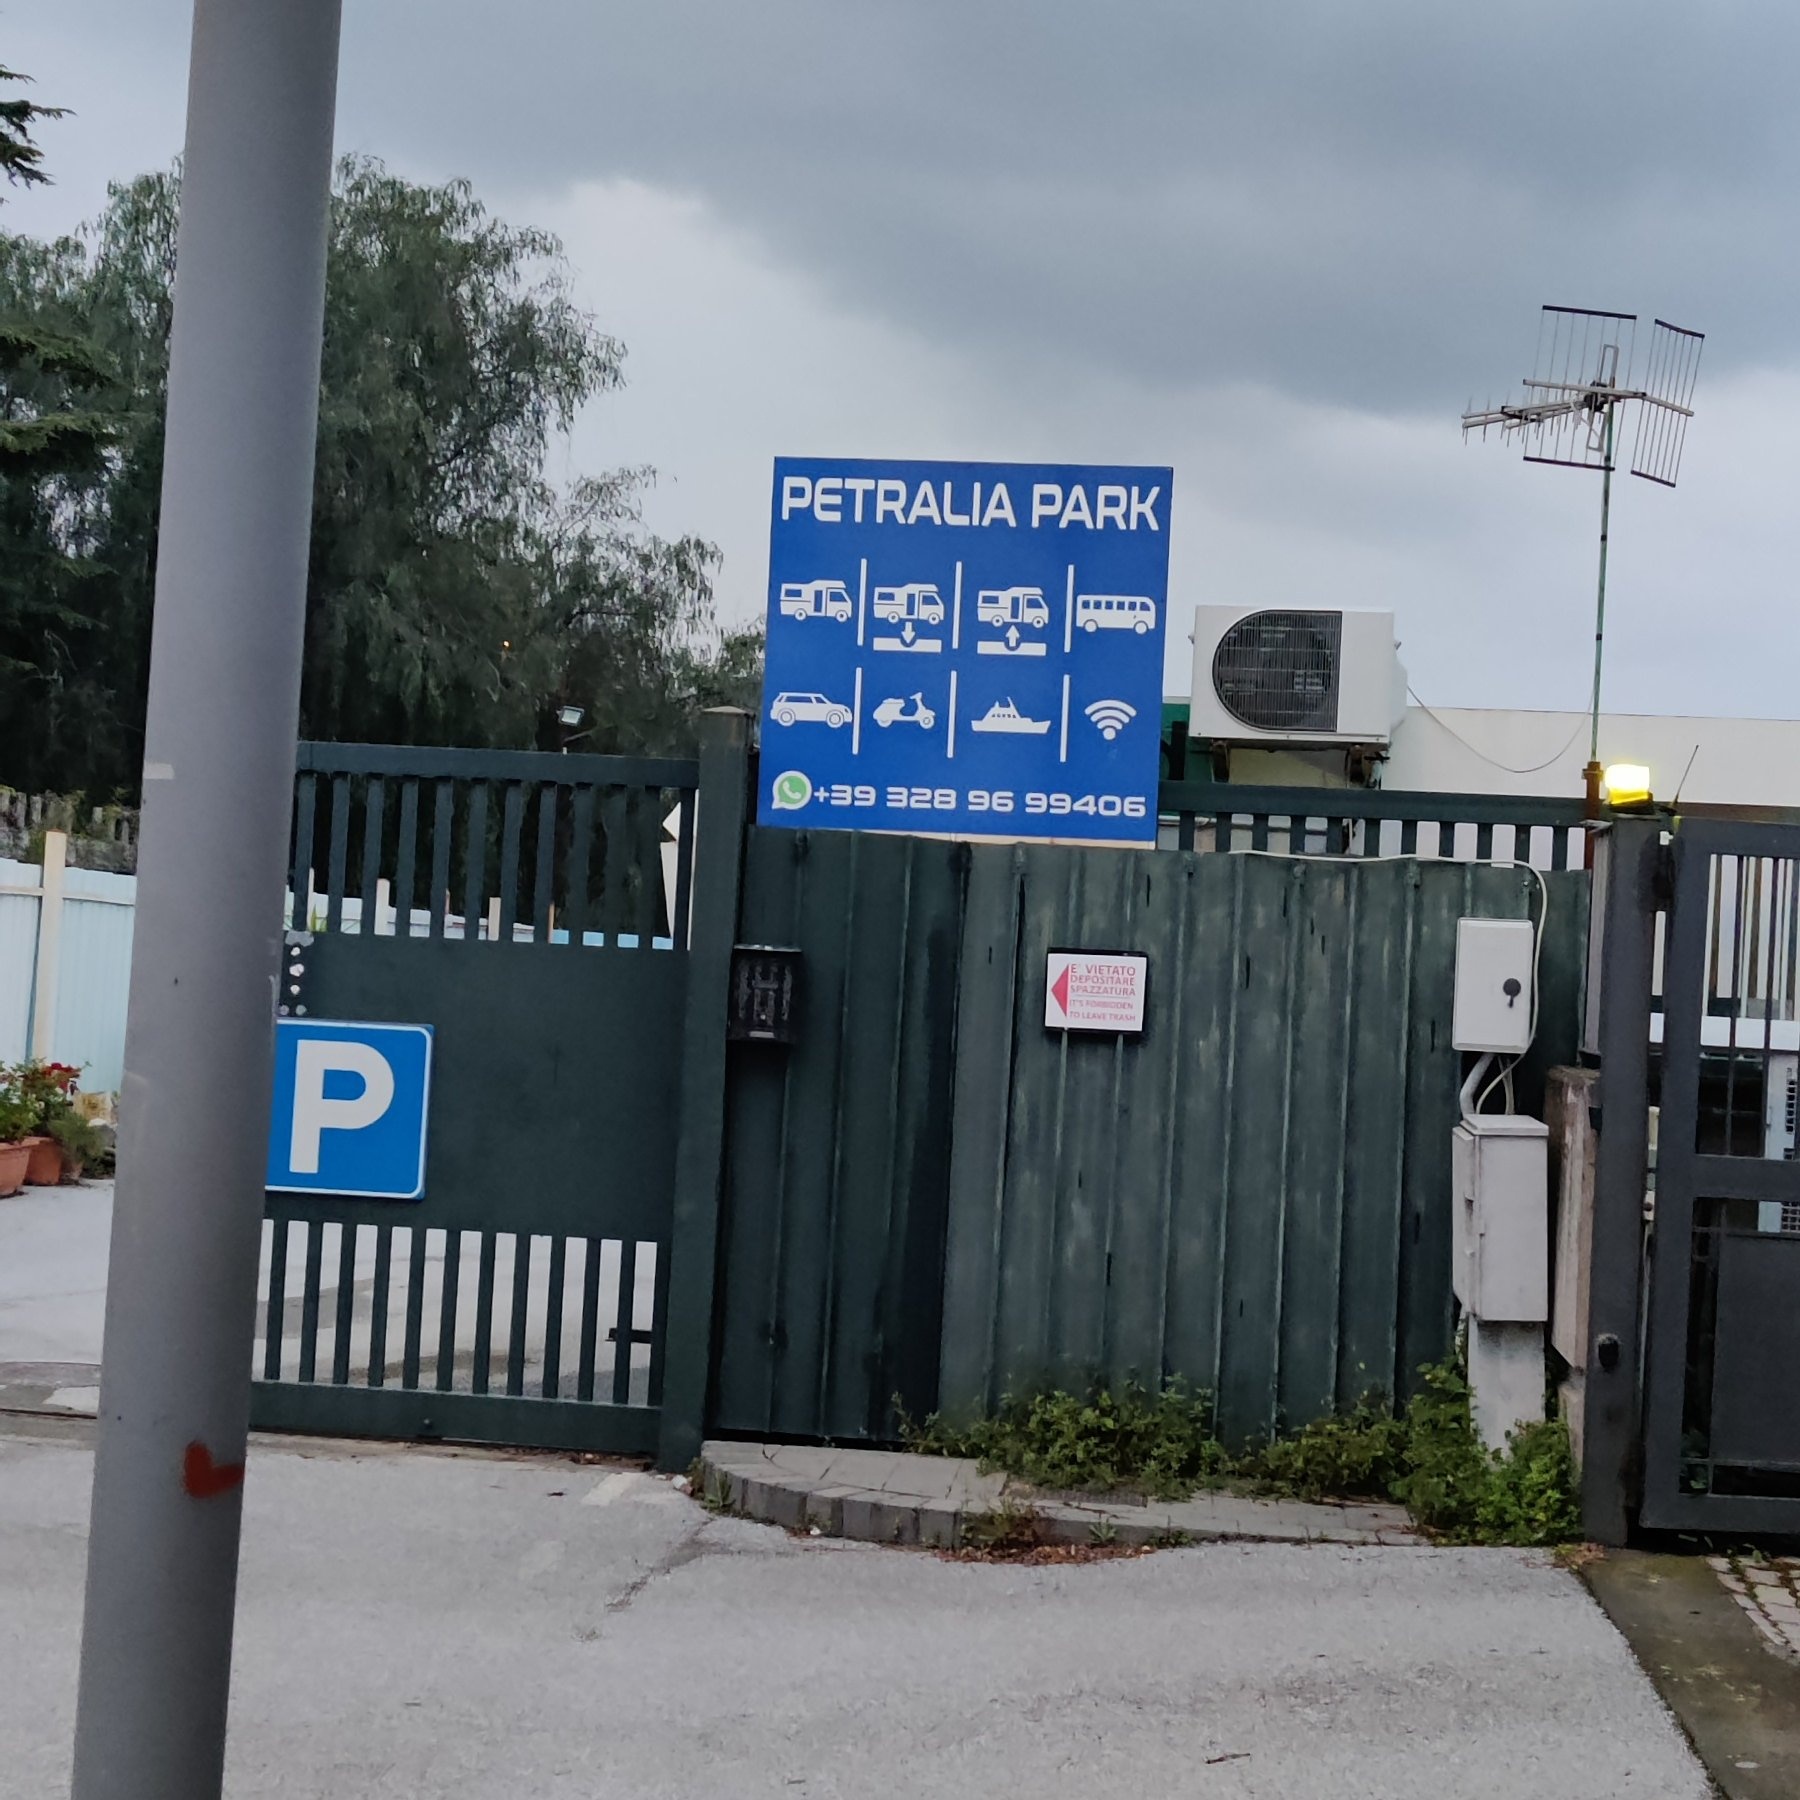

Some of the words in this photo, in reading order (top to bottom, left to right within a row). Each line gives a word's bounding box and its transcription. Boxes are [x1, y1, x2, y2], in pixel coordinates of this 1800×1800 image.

[781, 476, 1016, 527] PETRALIA
[1031, 484, 1160, 530] PARK
[813, 785, 876, 806] +39
[886, 787, 956, 810] 328
[966, 791, 1014, 813] 96
[1025, 793, 1146, 817] 99406
[1086, 964, 1136, 976] VIETATO
[1070, 975, 1135, 986] DEPOSITARE
[1070, 985, 1136, 996] SPAZZATURA
[1082, 1012, 1106, 1020] LEAVE
[1109, 1013, 1136, 1021] TRASH
[289, 1040, 394, 1174] P
